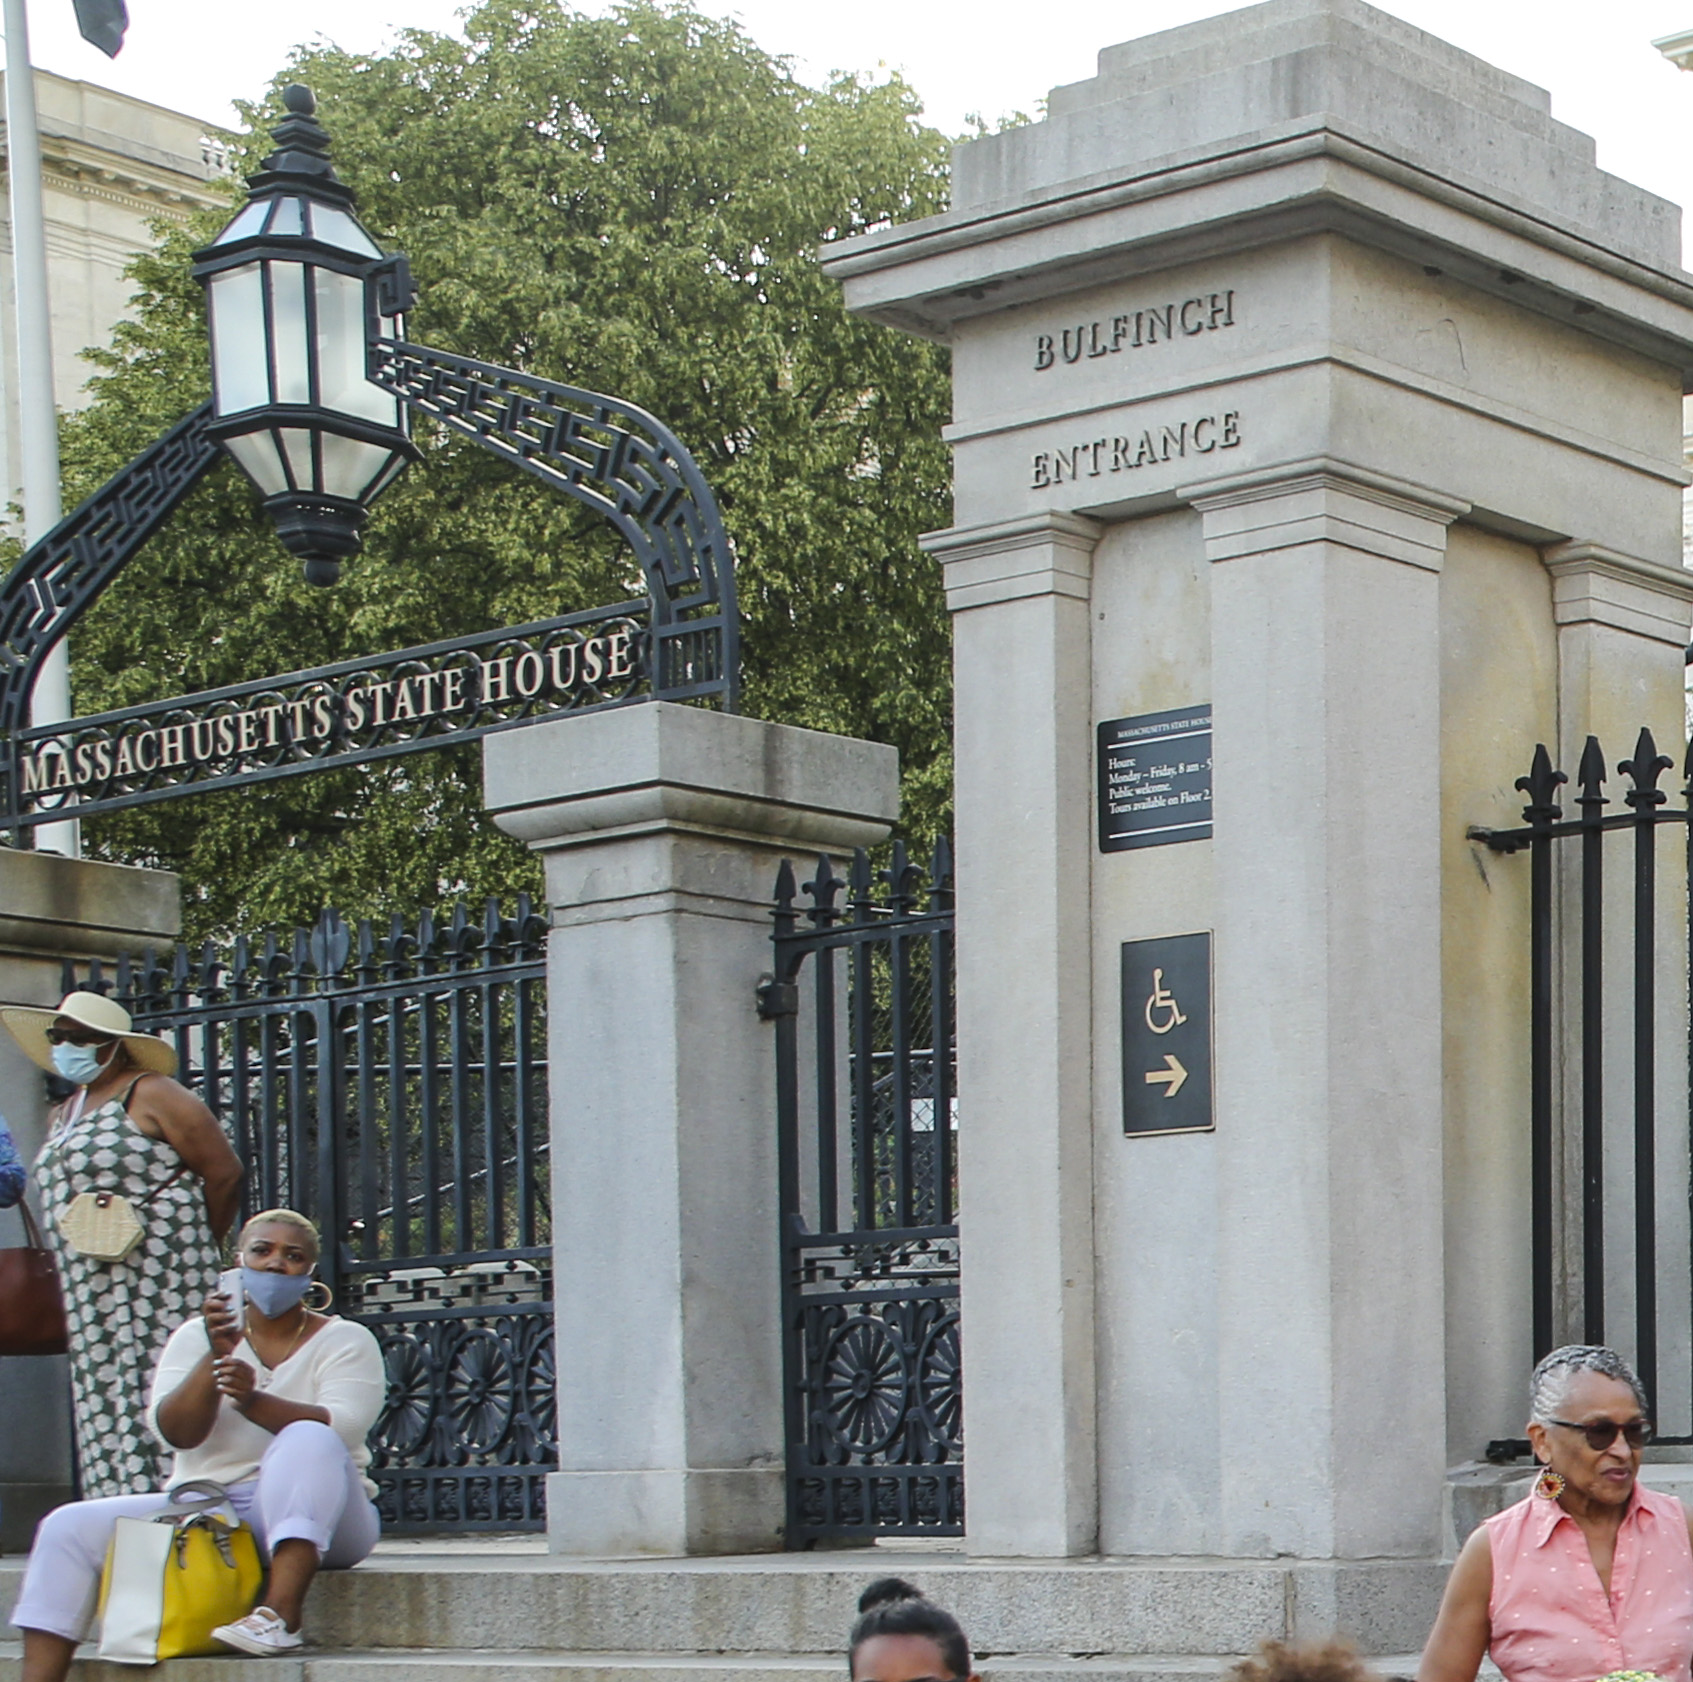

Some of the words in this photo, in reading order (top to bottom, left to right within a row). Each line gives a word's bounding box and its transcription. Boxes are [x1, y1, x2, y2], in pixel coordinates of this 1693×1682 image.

[1033, 289, 1235, 371] BULFINCH
[1030, 410, 1241, 489] ENTRANCE
[21, 694, 333, 794] MASSACHUSETTS
[346, 667, 466, 731] STATE
[481, 632, 633, 703] HOUSE
[1108, 770, 1142, 784] Monday
[1178, 762, 1185, 774] 8
[1186, 763, 1200, 773] am
[1109, 785, 1134, 800] Public
[1109, 802, 1132, 814] Tours
[1132, 795, 1167, 811] available
[1167, 796, 1179, 806] on
[1180, 790, 1202, 804] Floor
